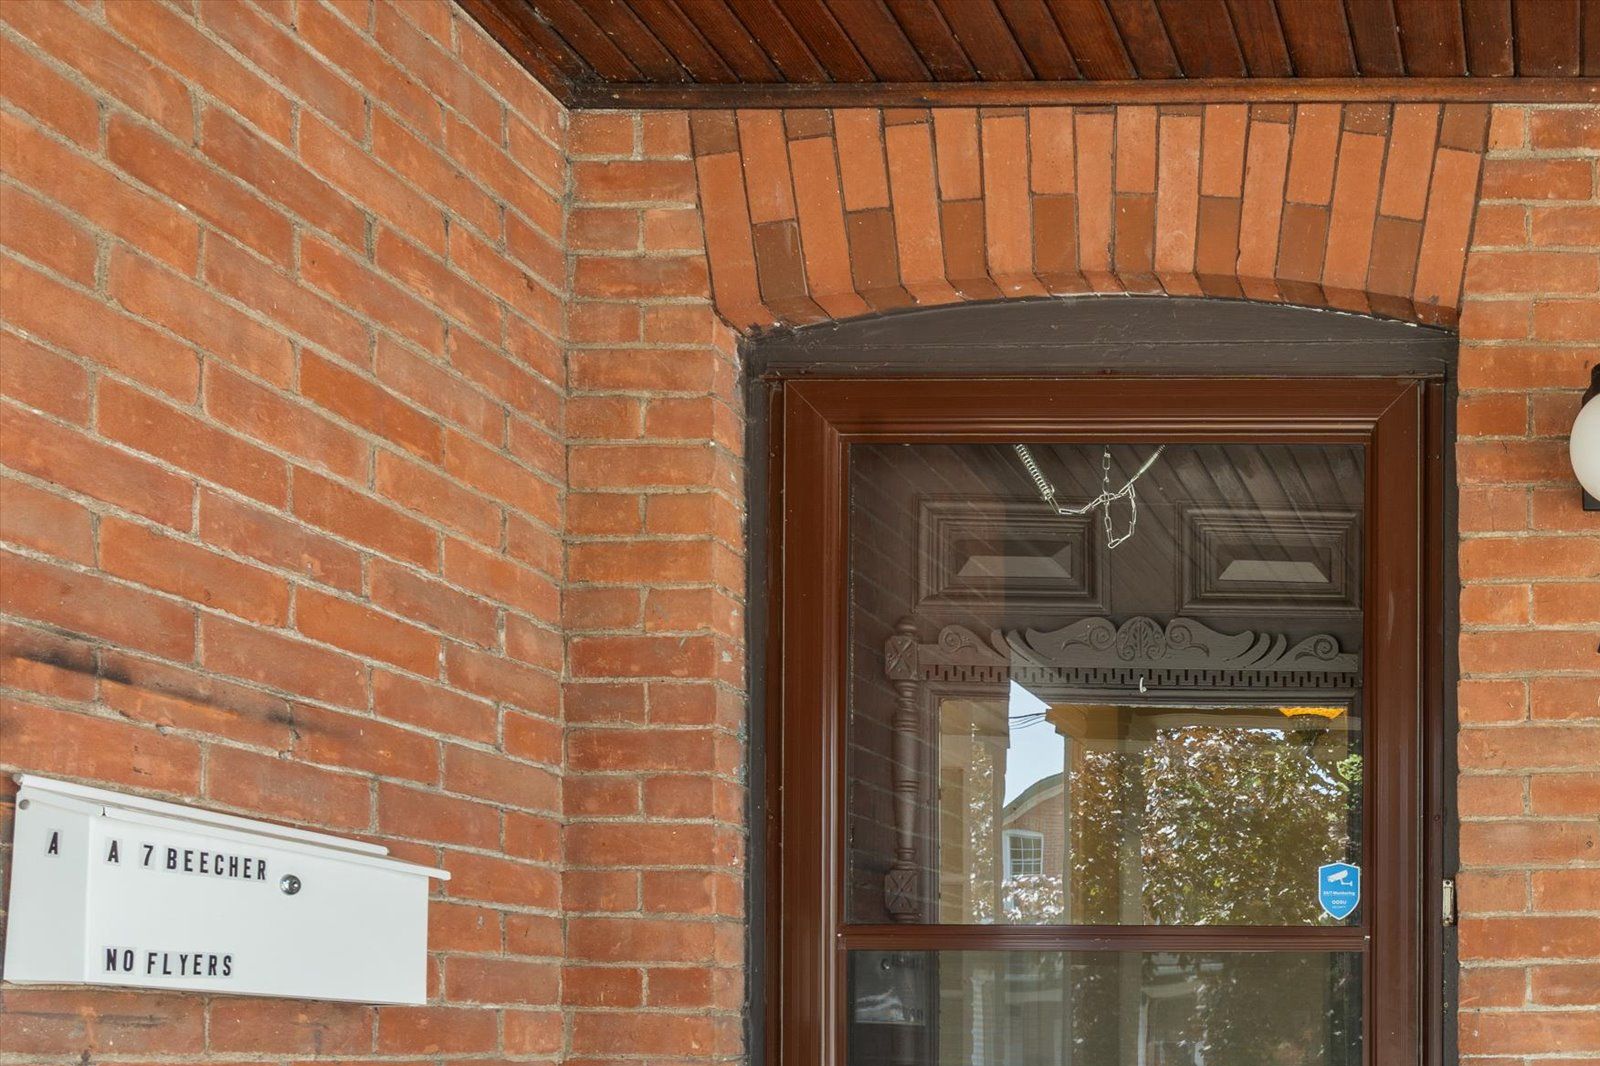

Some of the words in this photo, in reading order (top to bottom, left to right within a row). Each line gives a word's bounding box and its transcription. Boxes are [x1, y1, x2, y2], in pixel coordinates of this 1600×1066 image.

[48, 831, 59, 855] A
[107, 840, 119, 863] A
[143, 844, 154, 867] 7
[166, 848, 267, 881] BEECHER
[106, 948, 135, 973] NO
[146, 952, 232, 977] FLYERS
